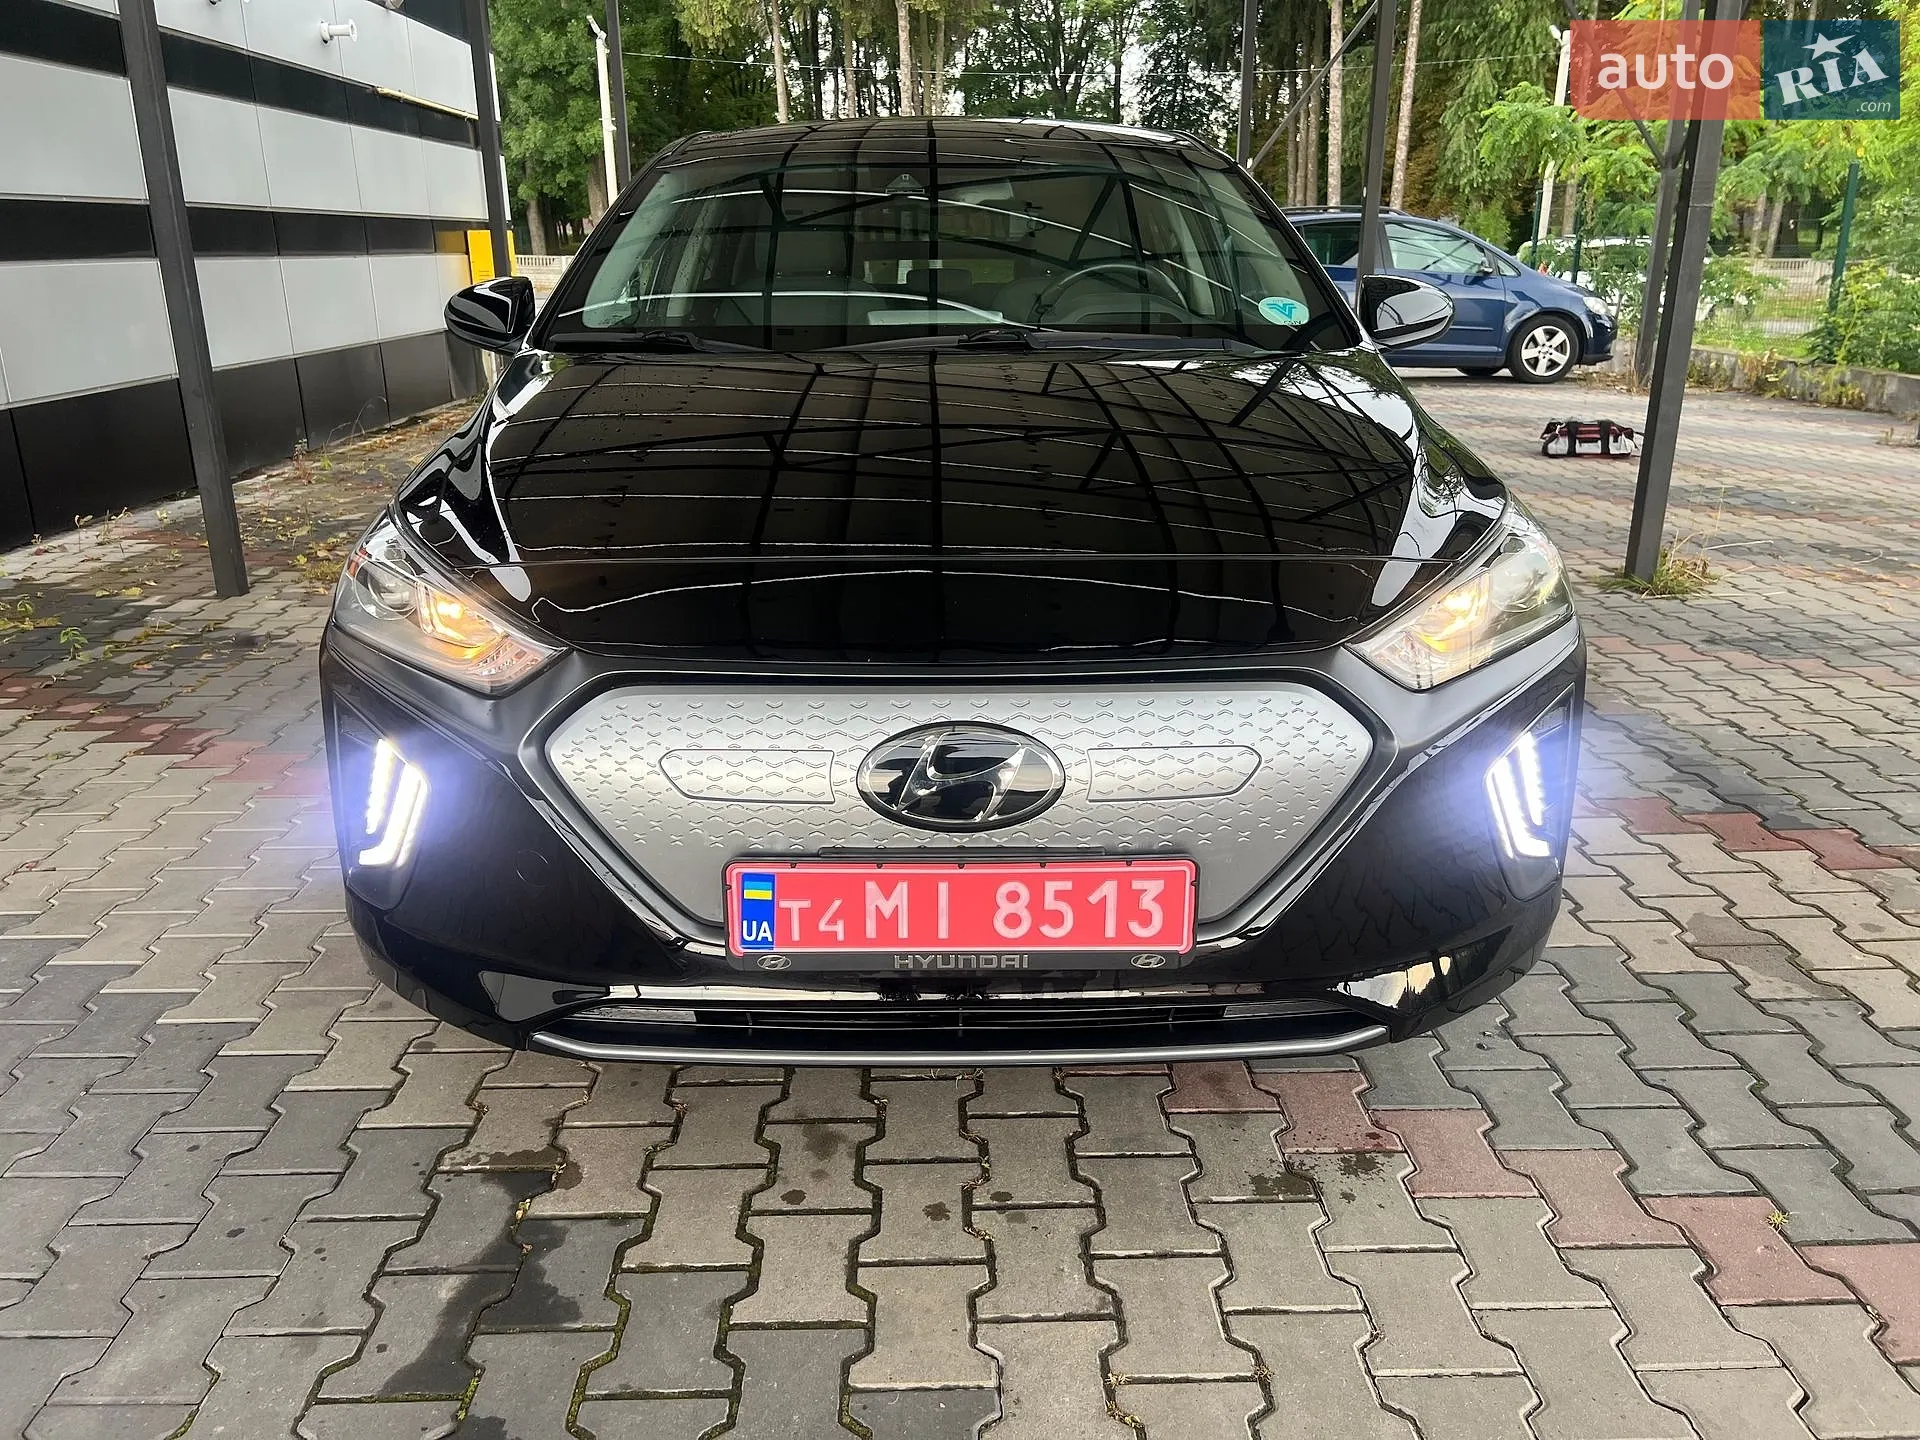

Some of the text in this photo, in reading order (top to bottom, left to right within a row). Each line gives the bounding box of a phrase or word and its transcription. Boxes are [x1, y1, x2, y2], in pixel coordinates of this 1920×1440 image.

[992, 878, 1165, 940] 8513
[742, 919, 773, 942] UA
[894, 953, 1030, 969] HYUNDAI
